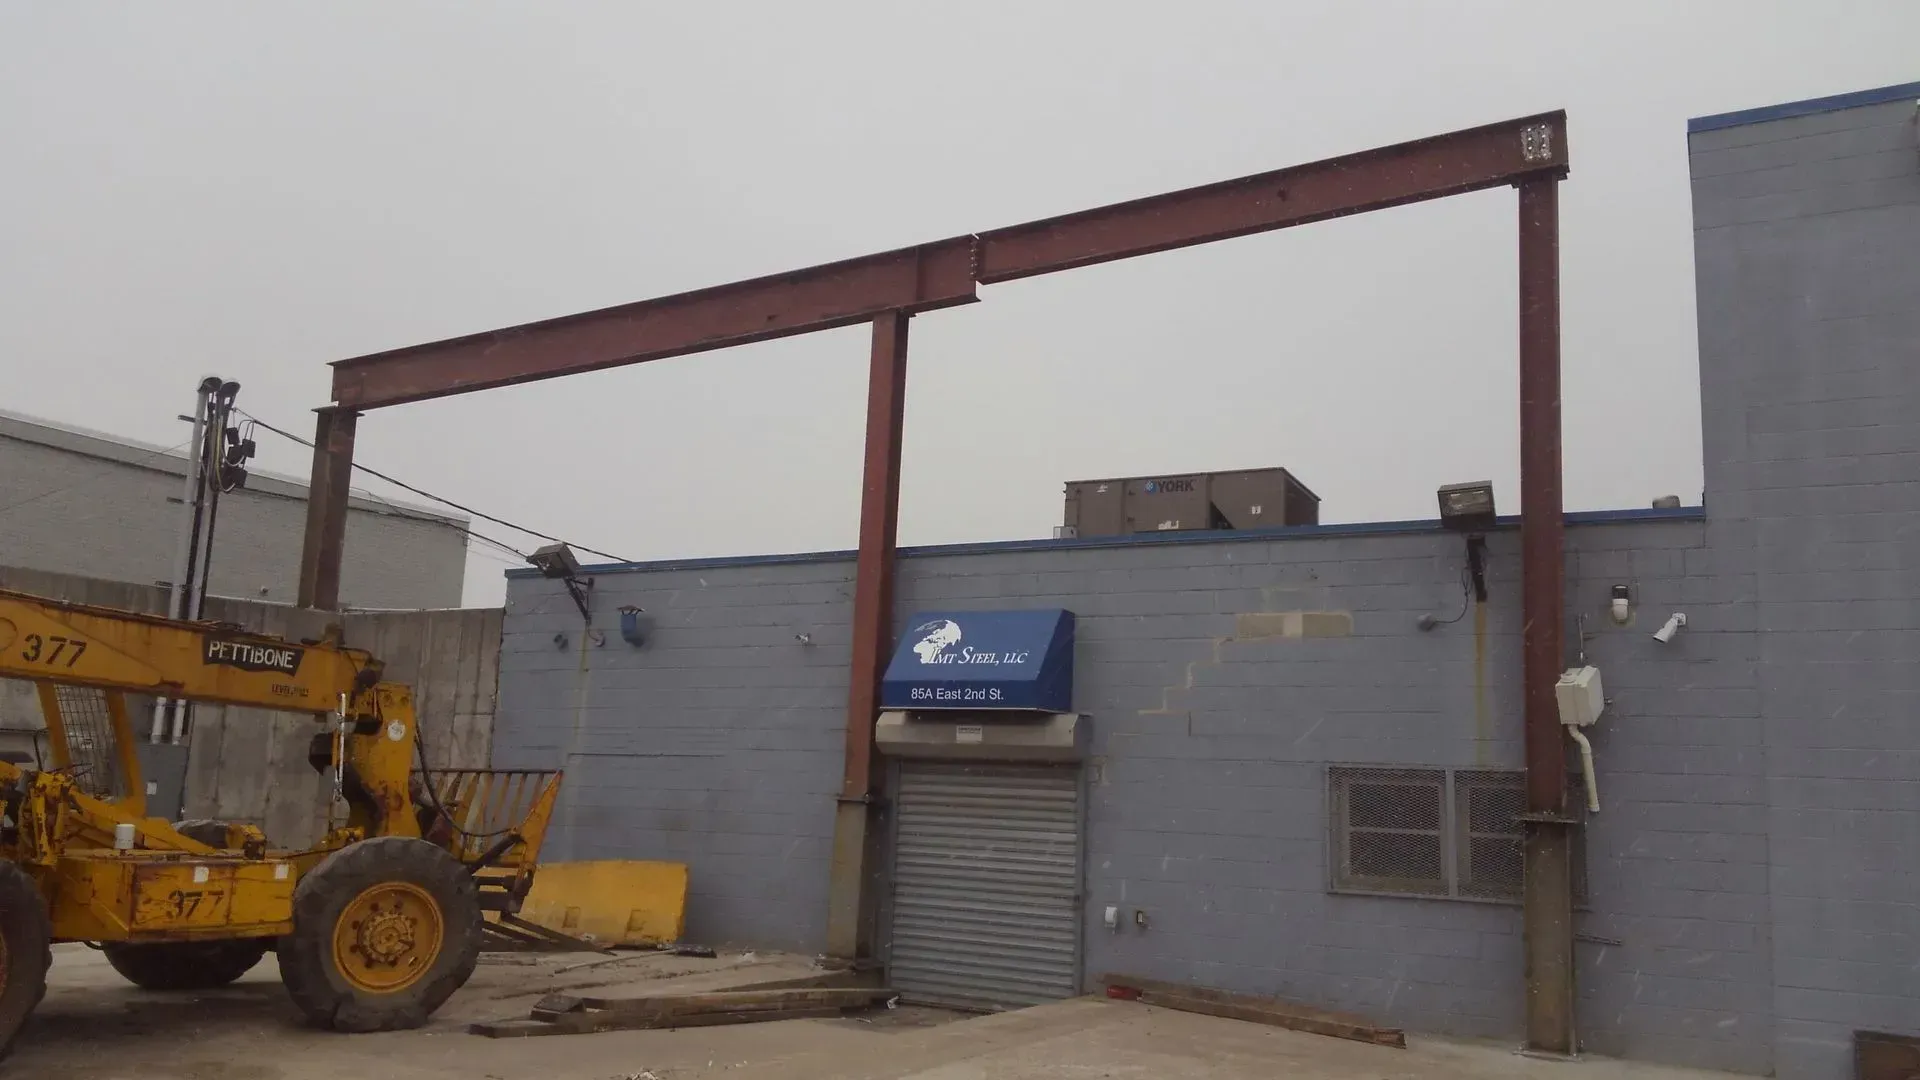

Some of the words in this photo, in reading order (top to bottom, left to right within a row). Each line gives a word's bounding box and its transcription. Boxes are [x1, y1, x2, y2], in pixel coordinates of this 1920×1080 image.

[1157, 479, 1197, 493] YORK
[22, 633, 87, 668] 377
[207, 640, 294, 669] PETTIBONE
[1002, 652, 1028, 664] LLC
[911, 688, 933, 700] 85A
[936, 688, 961, 700] East
[964, 688, 986, 700] 2nd
[989, 688, 1004, 700] St.
[166, 889, 225, 919] 377
